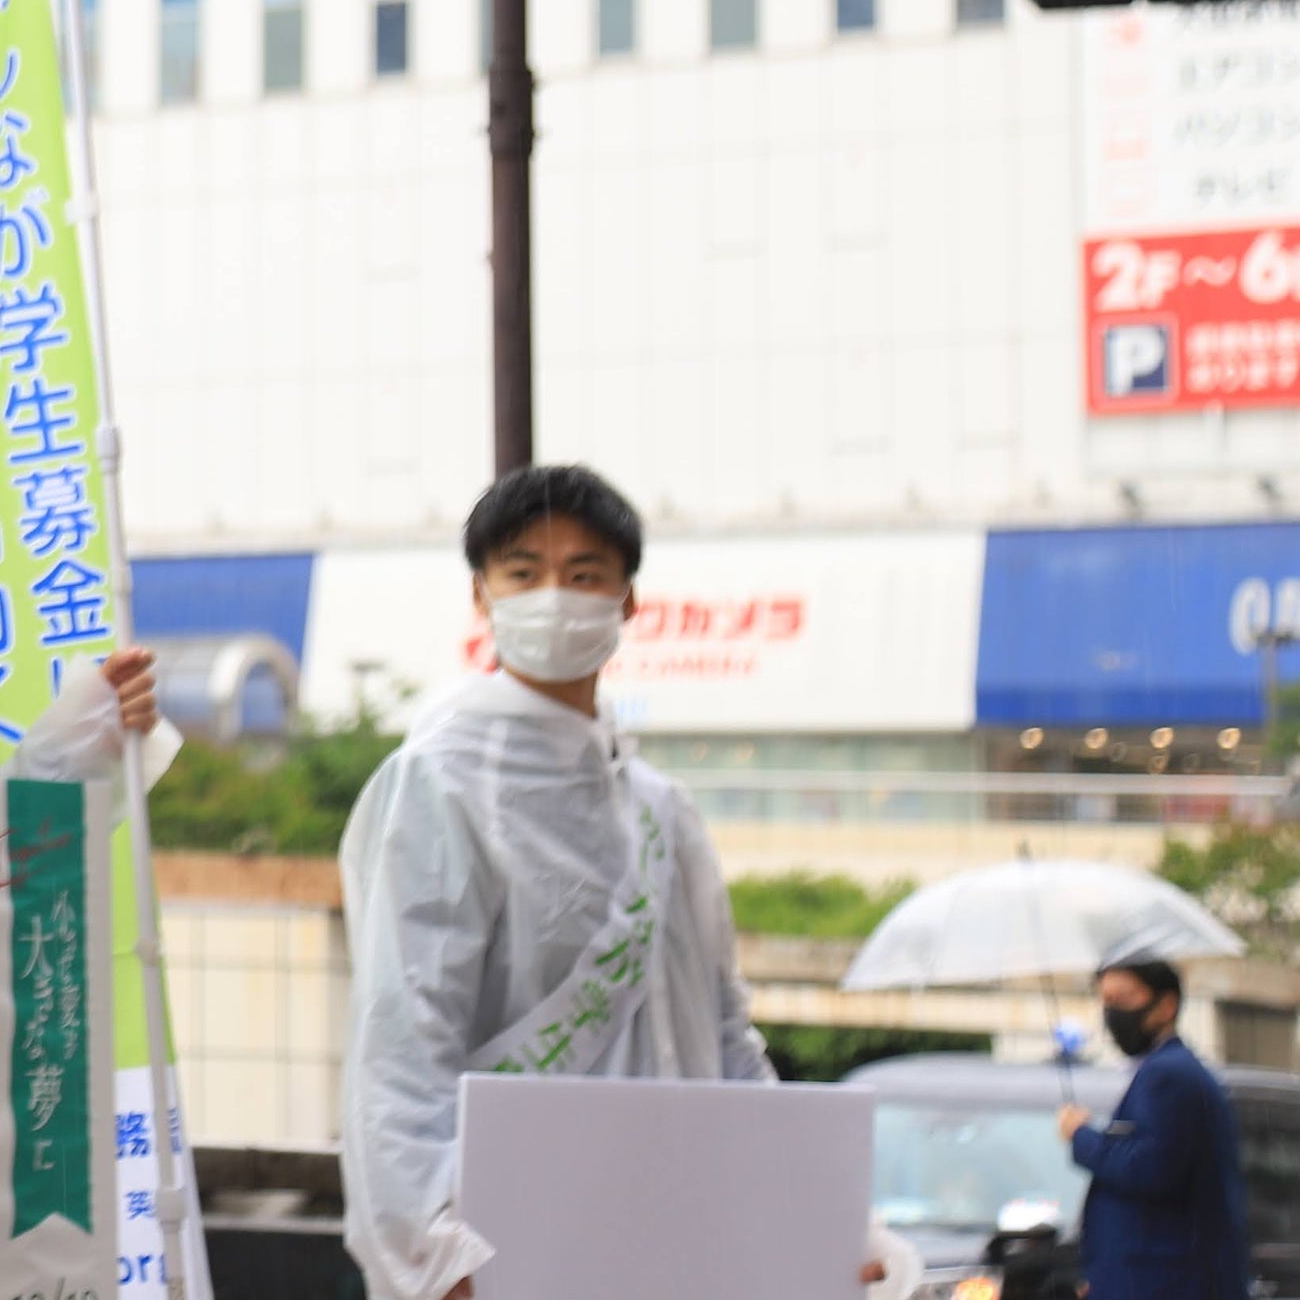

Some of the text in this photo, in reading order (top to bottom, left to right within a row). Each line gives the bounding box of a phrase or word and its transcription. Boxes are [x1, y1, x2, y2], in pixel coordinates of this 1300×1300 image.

[17, 913, 66, 1173] 大きな夢に
